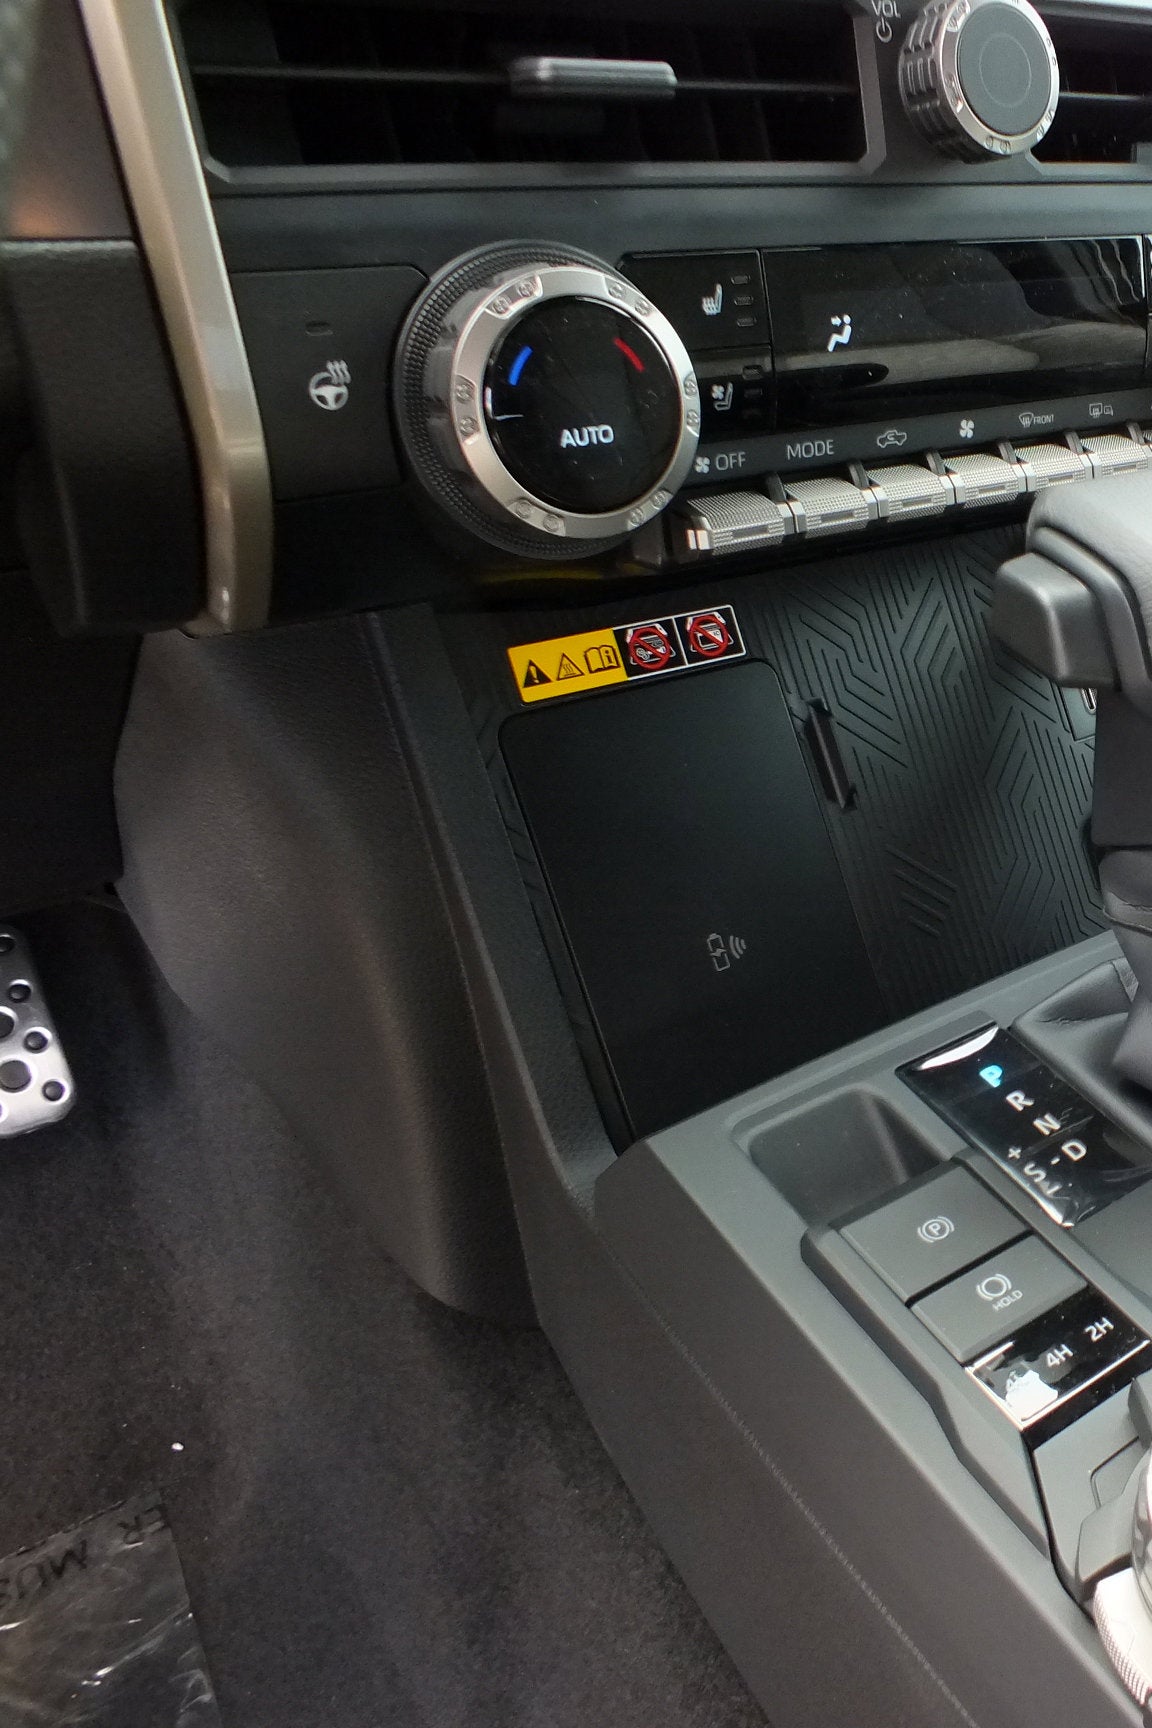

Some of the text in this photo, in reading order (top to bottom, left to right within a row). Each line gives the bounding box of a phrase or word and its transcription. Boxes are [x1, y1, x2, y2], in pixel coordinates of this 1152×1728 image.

[871, 0, 901, 18] VOL
[1033, 414, 1054, 425] FRONT
[560, 424, 614, 448] AUTO
[786, 439, 834, 460] MODE
[715, 452, 746, 471] OFF
[979, 1064, 1003, 1088] P
[1005, 1090, 1035, 1112] R
[1033, 1113, 1061, 1135] N
[1061, 1139, 1087, 1162] D
[992, 1289, 1023, 1312] HOLD
[1083, 1316, 1114, 1342] 2H
[1046, 1343, 1074, 1368] 4H
